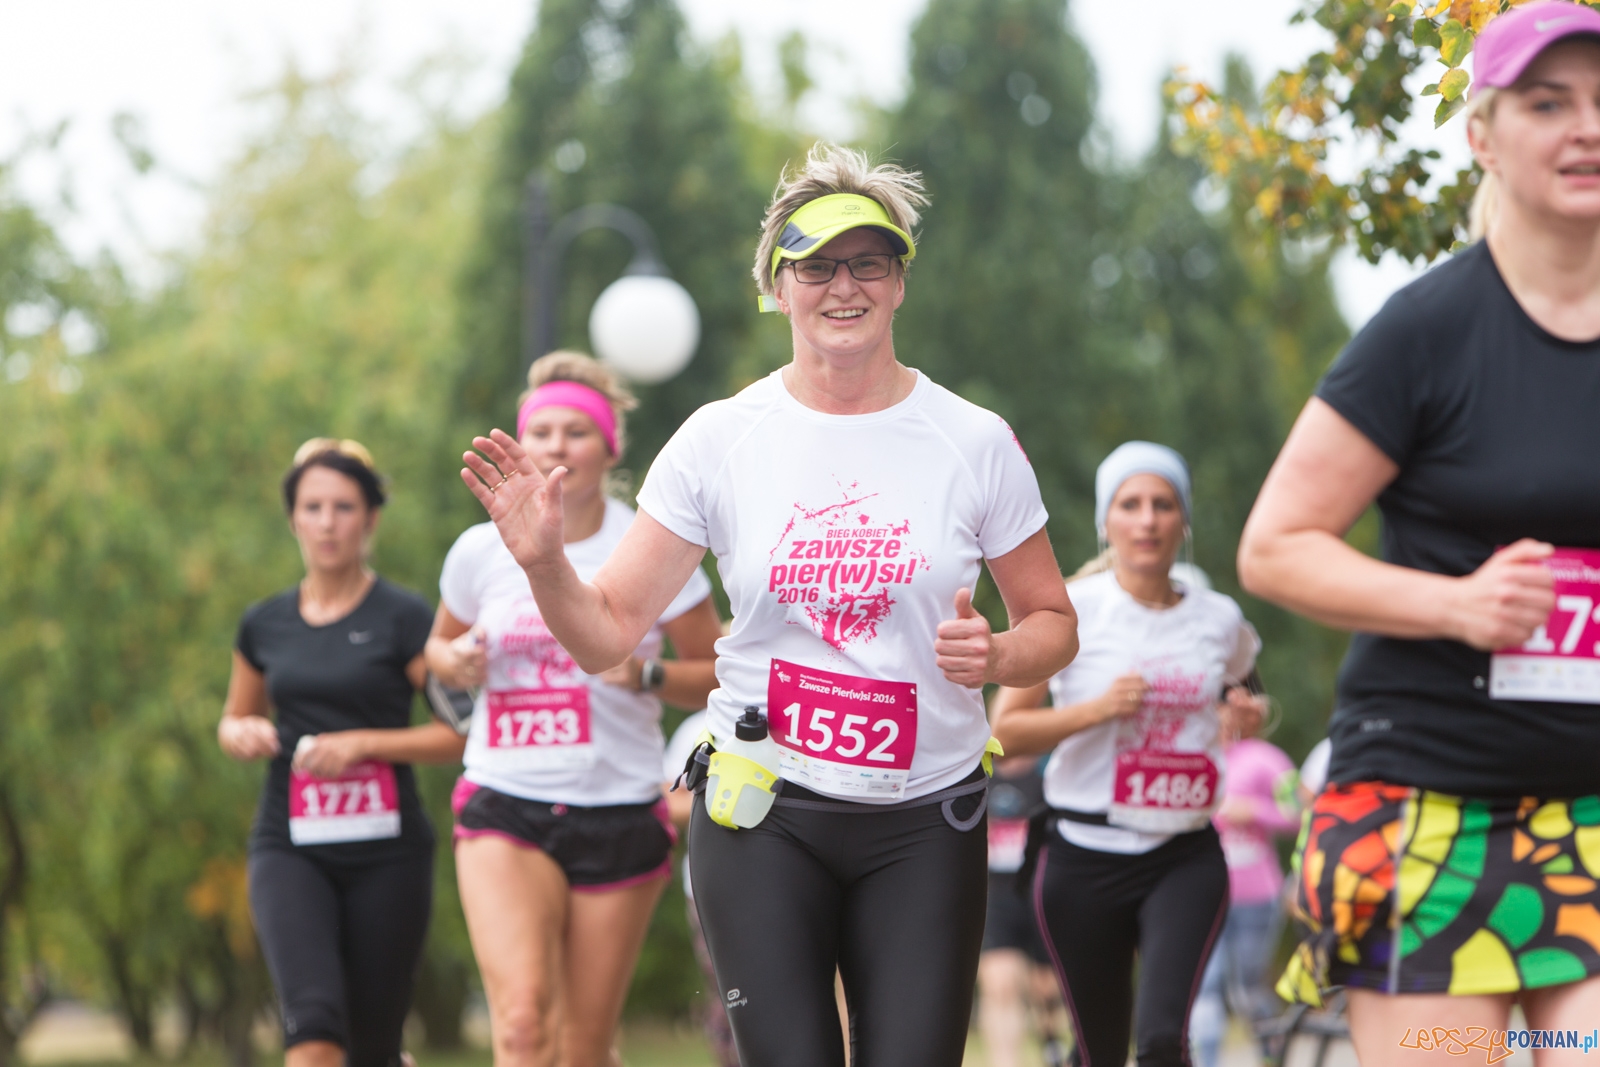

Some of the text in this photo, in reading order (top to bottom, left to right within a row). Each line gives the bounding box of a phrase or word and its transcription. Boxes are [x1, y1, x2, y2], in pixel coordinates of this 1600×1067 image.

[826, 528, 889, 538] BIEG KOBIET
[788, 538, 901, 559] zawsze
[777, 587, 819, 604] 2016
[798, 680, 896, 704] Zawsze Pier(w)si 2016
[496, 708, 580, 747] 1733
[783, 702, 900, 763] 1552
[300, 778, 387, 817] 1771
[1125, 771, 1211, 808] 1486
